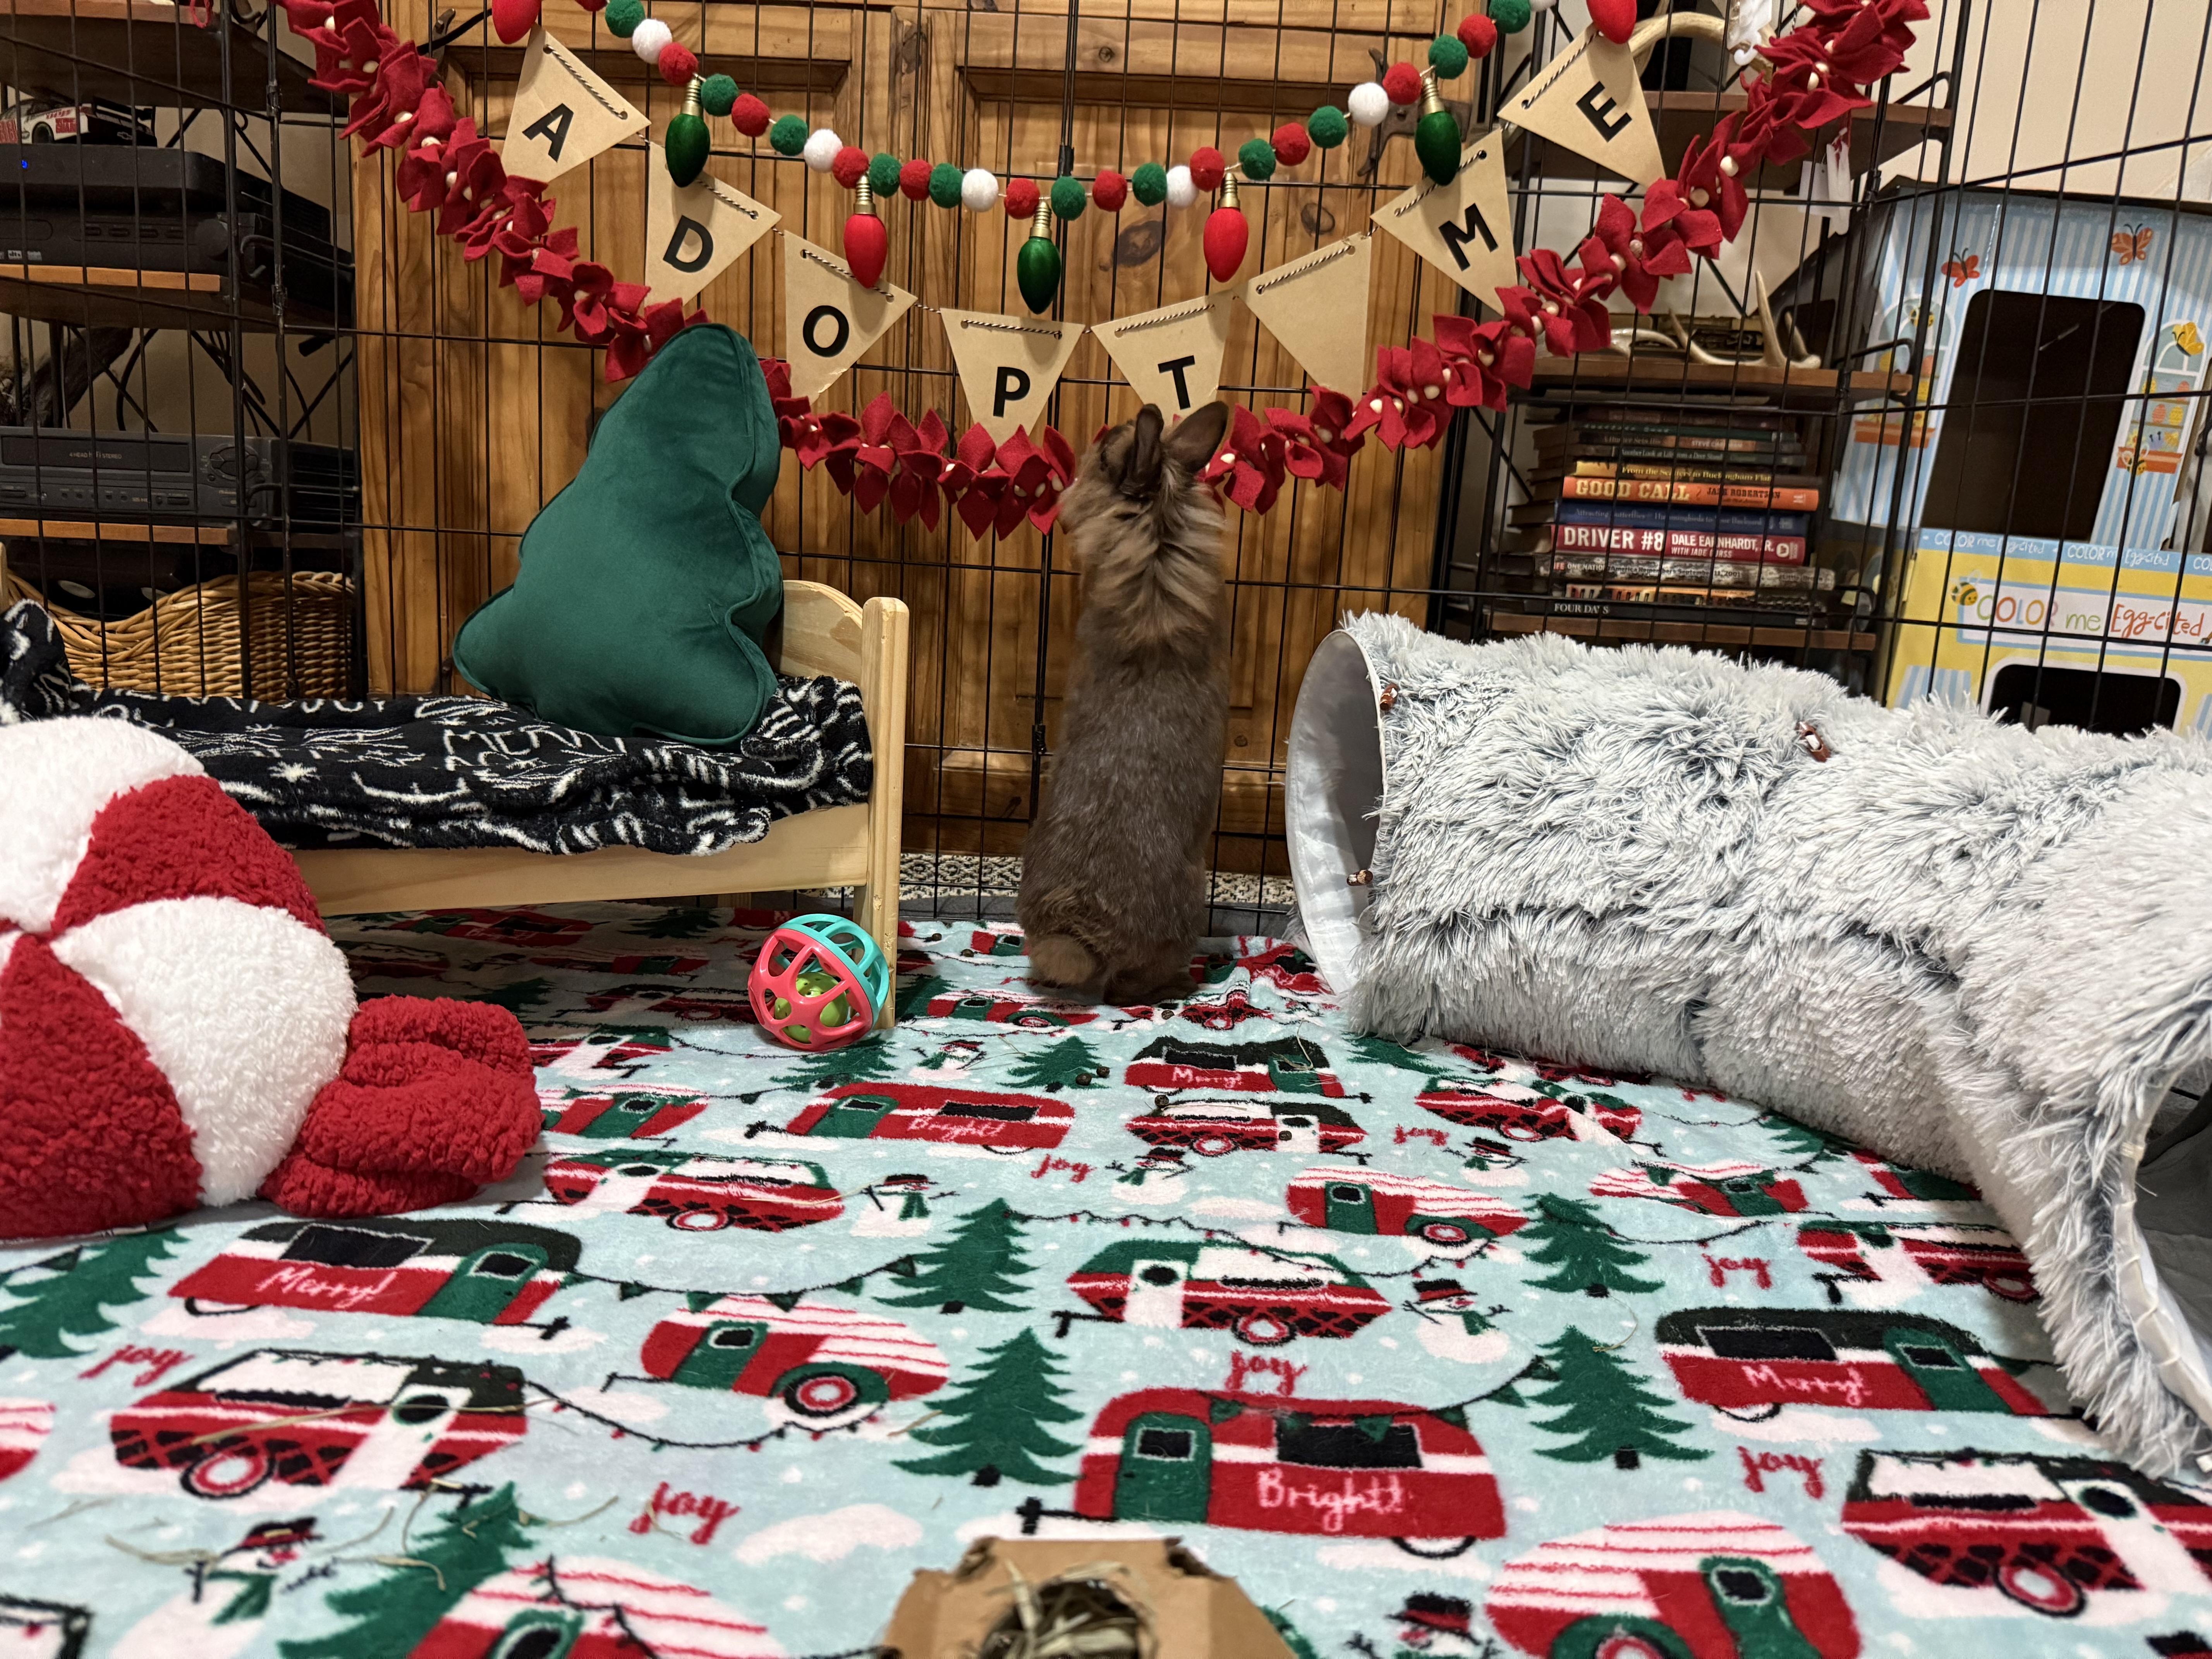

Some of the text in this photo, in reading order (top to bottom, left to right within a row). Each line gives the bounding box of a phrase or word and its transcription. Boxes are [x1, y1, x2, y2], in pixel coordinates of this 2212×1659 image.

[1622, 467, 1643, 475] From
[1575, 479, 1690, 501] GOOD CALL
[1731, 488, 1780, 499] ROBERTSN
[1564, 527, 1665, 552] DRIVER #8
[1671, 533, 1697, 546] DALE
[1671, 546, 1688, 555] WITH
[1690, 547, 1707, 557] JADE
[1934, 532, 1975, 548] COOR
[2067, 545, 2104, 561] COLOR
[1553, 562, 1565, 570] IFE
[1583, 563, 1607, 571] NATIO
[1554, 603, 1582, 613] FOUR
[2065, 613, 2101, 631] me
[2110, 603, 2205, 639] Egg-cited
[1030, 1154, 1097, 1184] joy
[1702, 1253, 1772, 1290] joy
[256, 1266, 398, 1310] Merry!
[79, 1343, 195, 1388] joy
[1225, 1350, 1309, 1396] joy
[1738, 1446, 1826, 1500] joy
[628, 1481, 742, 1545] joy
[1257, 1468, 1410, 1533] Bright!
